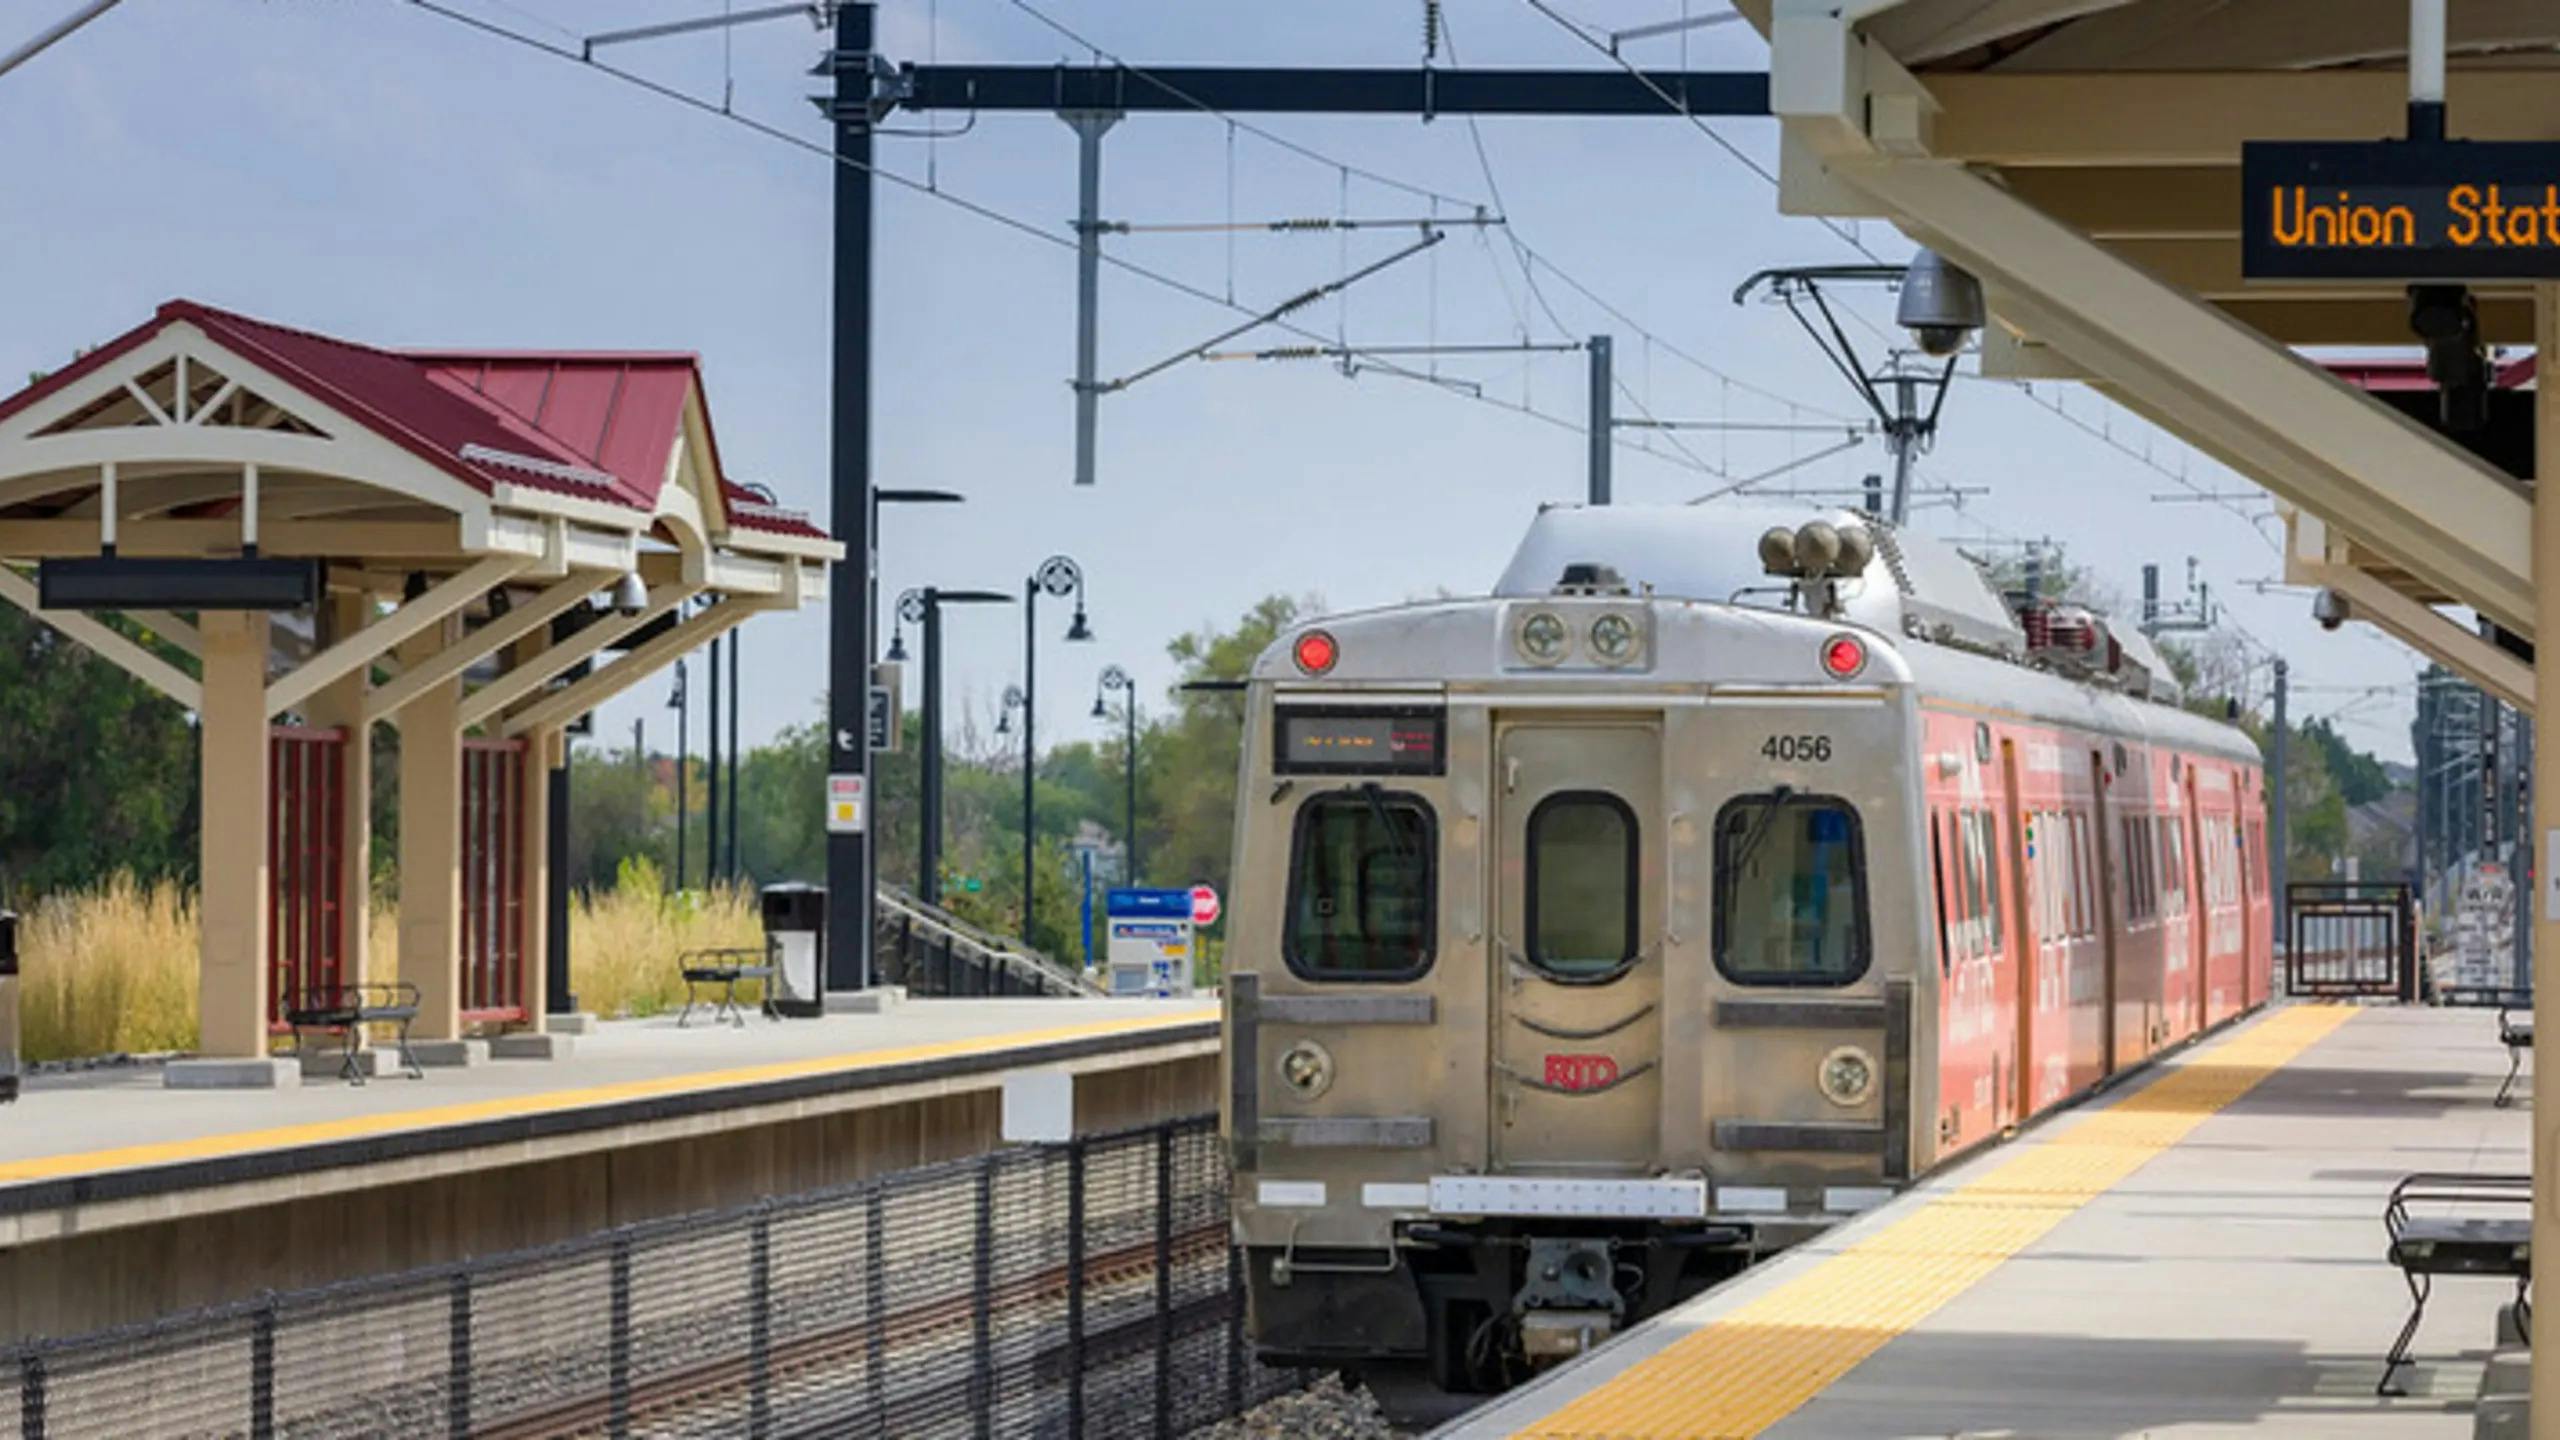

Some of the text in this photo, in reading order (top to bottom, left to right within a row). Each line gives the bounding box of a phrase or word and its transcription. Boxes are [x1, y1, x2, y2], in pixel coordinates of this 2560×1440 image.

[2272, 184, 2415, 246] Union
[1761, 735, 1832, 762] 4056
[1544, 1053, 1618, 1091] RTD
